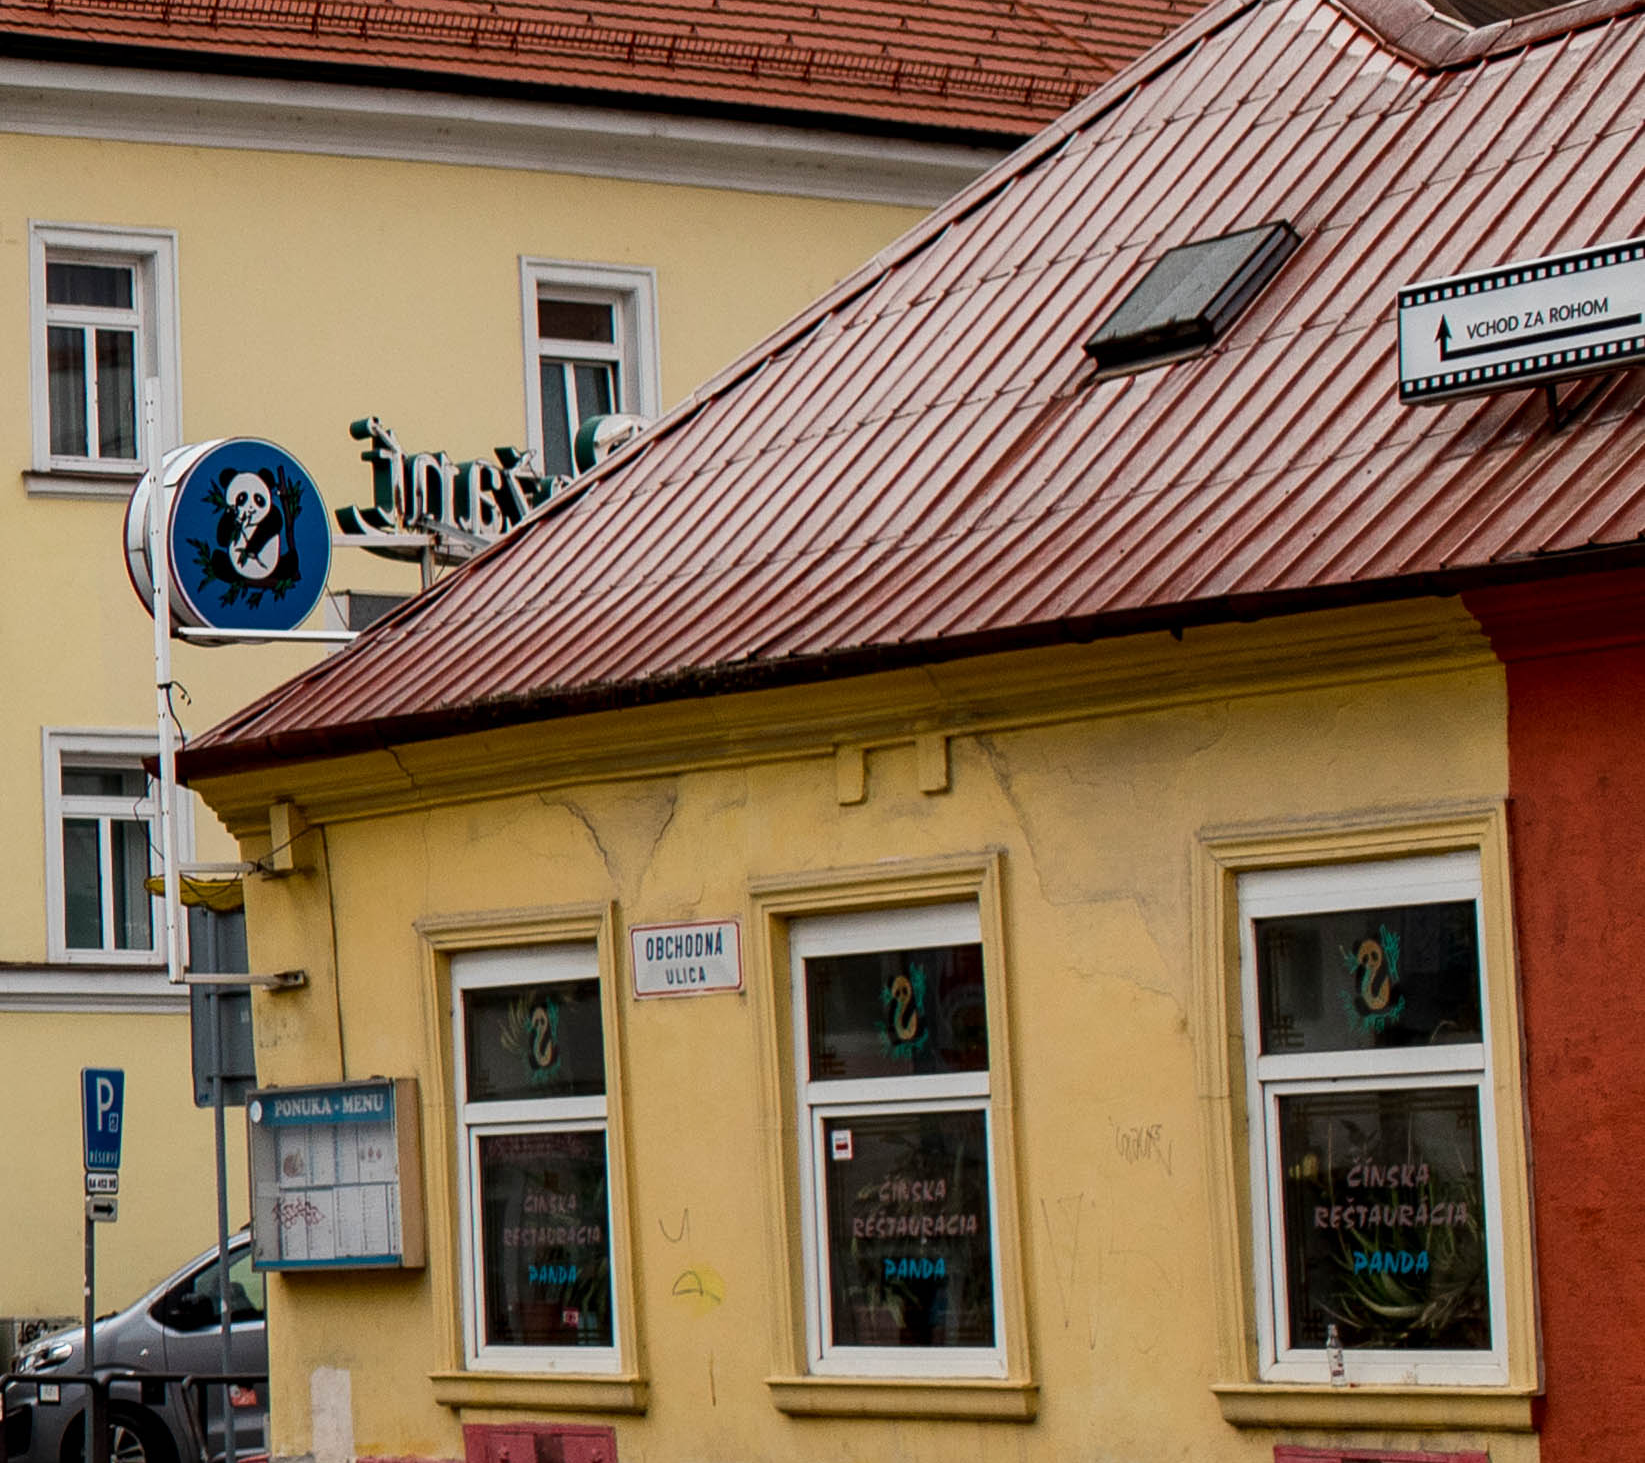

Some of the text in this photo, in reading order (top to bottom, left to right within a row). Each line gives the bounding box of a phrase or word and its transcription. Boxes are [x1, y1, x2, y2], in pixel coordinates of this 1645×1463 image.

[1466, 297, 1609, 339] VCHOD ZA ROHOM
[646, 926, 723, 962] OBCHODNÁ
[666, 966, 706, 985] ULICA
[274, 1097, 332, 1117] PONUKA
[342, 1093, 385, 1114] MENU
[1346, 1156, 1431, 1188] ČÍNSKA
[1314, 1196, 1469, 1229] REŠTAURÁCIA
[528, 1264, 578, 1285] PANDA
[883, 1257, 946, 1282] PANDA
[1352, 1250, 1431, 1276] PANDA
